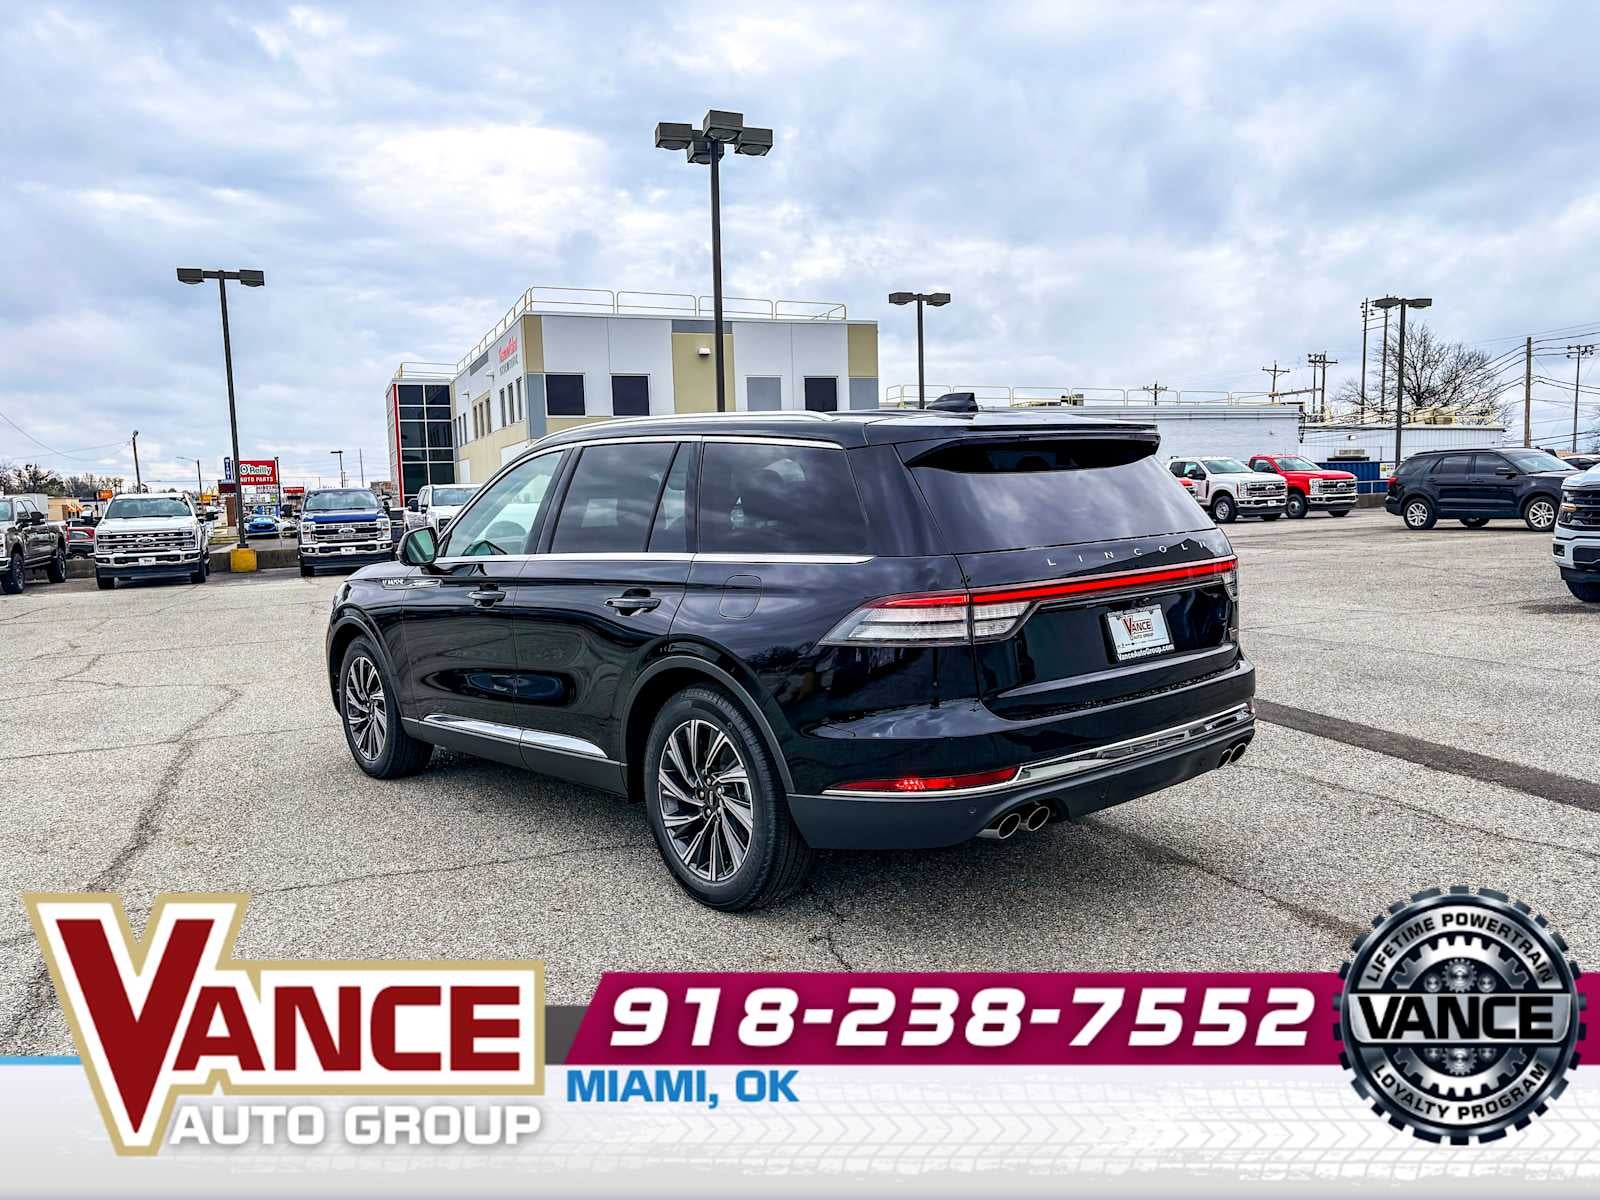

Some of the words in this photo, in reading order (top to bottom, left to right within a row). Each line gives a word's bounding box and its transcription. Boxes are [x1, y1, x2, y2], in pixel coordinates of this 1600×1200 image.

[240, 464, 272, 475] O'Reilly
[1047, 541, 1207, 566] LINCOLN
[1122, 615, 1152, 637] VANCE
[1117, 643, 1175, 661] VanceAutoGroup.com
